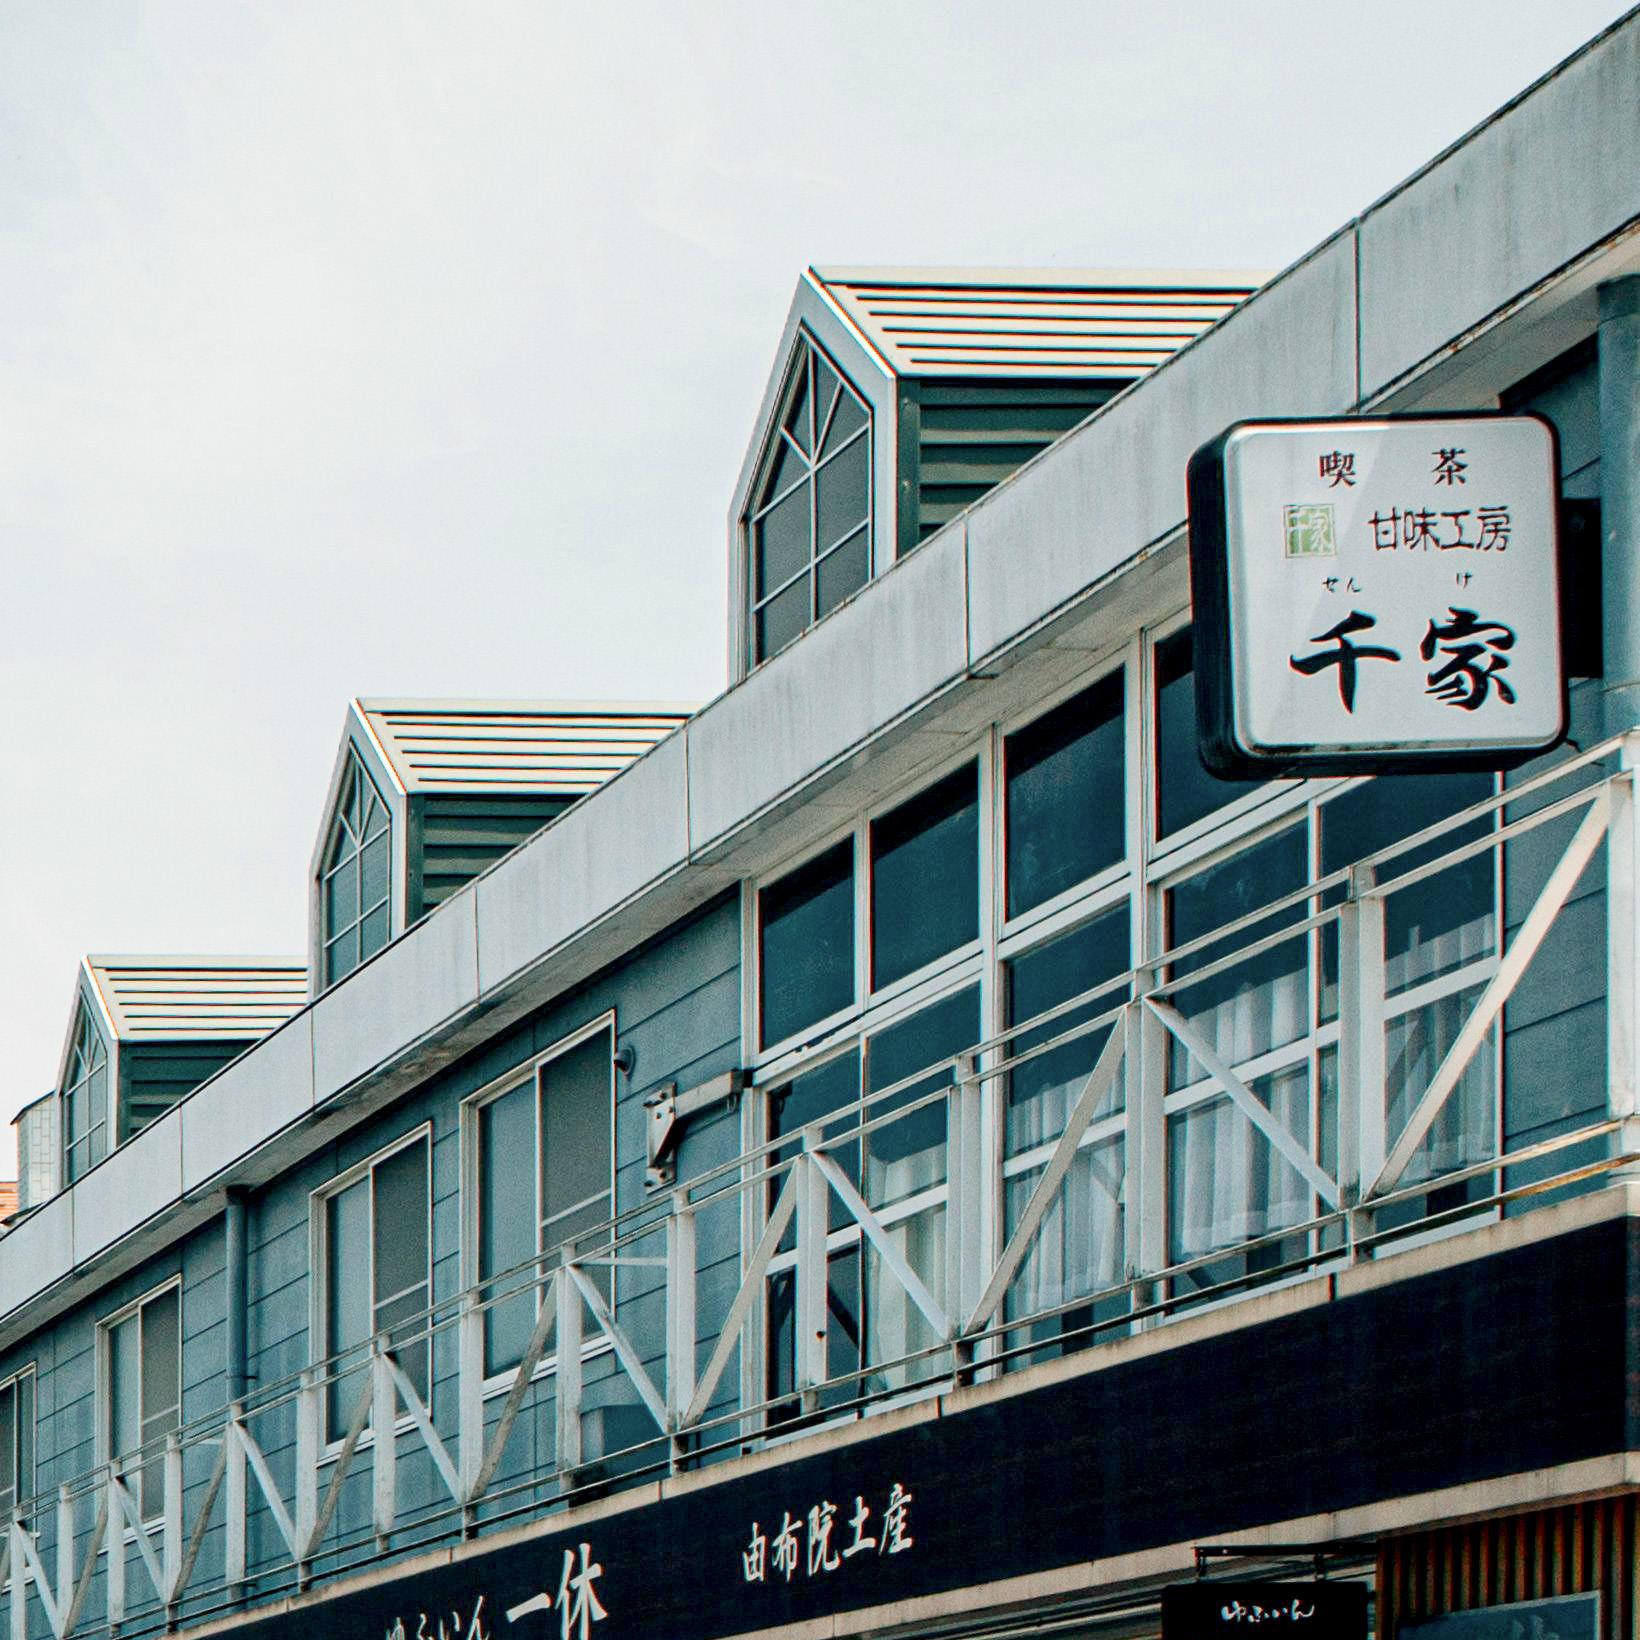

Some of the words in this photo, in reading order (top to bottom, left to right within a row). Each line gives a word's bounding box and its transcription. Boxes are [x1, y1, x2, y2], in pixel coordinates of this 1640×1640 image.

[1367, 504, 1513, 553] 甘味工房
[1322, 575, 1362, 594] せん
[1289, 607, 1518, 714] 千家
[742, 1485, 913, 1582] 由布院土産
[1221, 1599, 1316, 1622] ゆふいん
